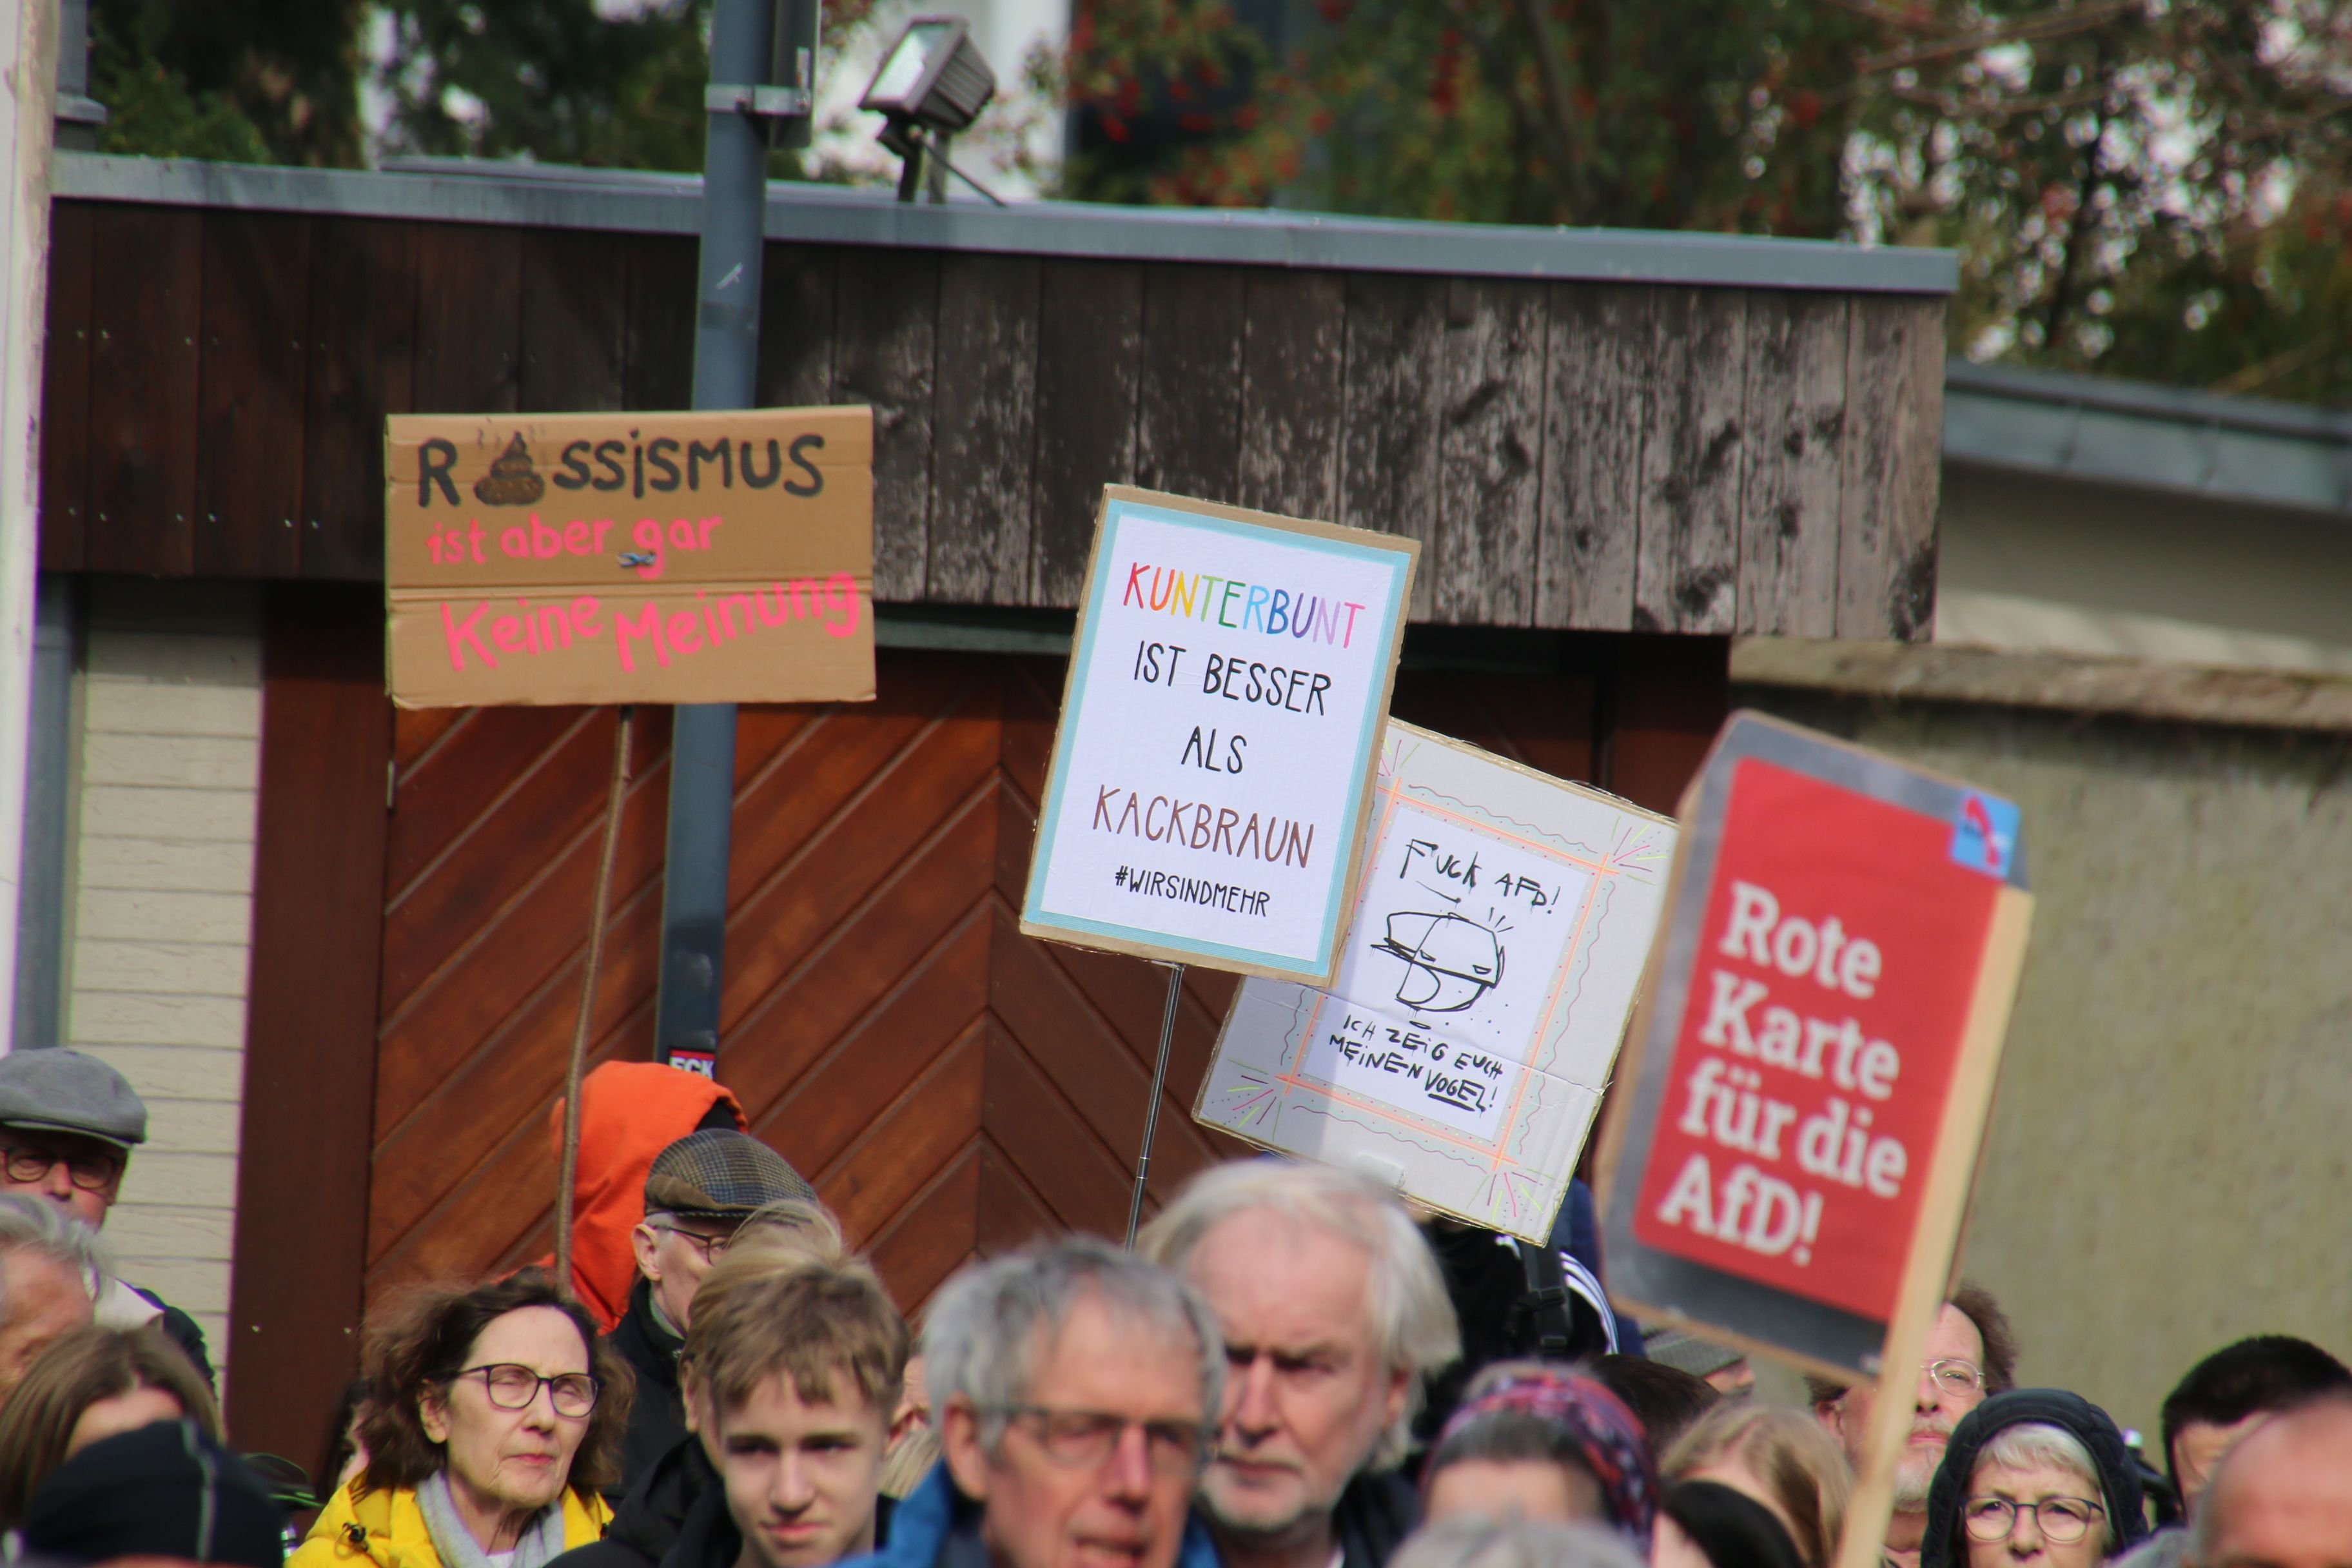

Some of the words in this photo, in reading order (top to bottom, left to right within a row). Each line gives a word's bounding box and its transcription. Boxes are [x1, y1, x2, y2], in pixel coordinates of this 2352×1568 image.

[426, 519, 487, 564] ist
[500, 513, 614, 559] aber
[632, 516, 722, 580] gar
[442, 595, 603, 671] Keine
[615, 571, 859, 672] Meinung
[1122, 562, 1366, 649] KUNTERBUNT
[1134, 640, 1186, 686] IST
[1203, 654, 1331, 716] BESSER
[1181, 726, 1247, 774] ALS
[1093, 785, 1314, 868] KACKBRAUN
[1115, 865, 1270, 916] #WIRSINDMEHR
[1720, 881, 1881, 997] Rote
[1343, 1014, 1377, 1041] ICH
[1454, 1052, 1504, 1080] EUCH
[1701, 970, 1899, 1098] Karte
[1681, 1059, 1796, 1159] für
[1798, 1099, 1906, 1197] die
[1658, 1154, 1823, 1266] AfD!
